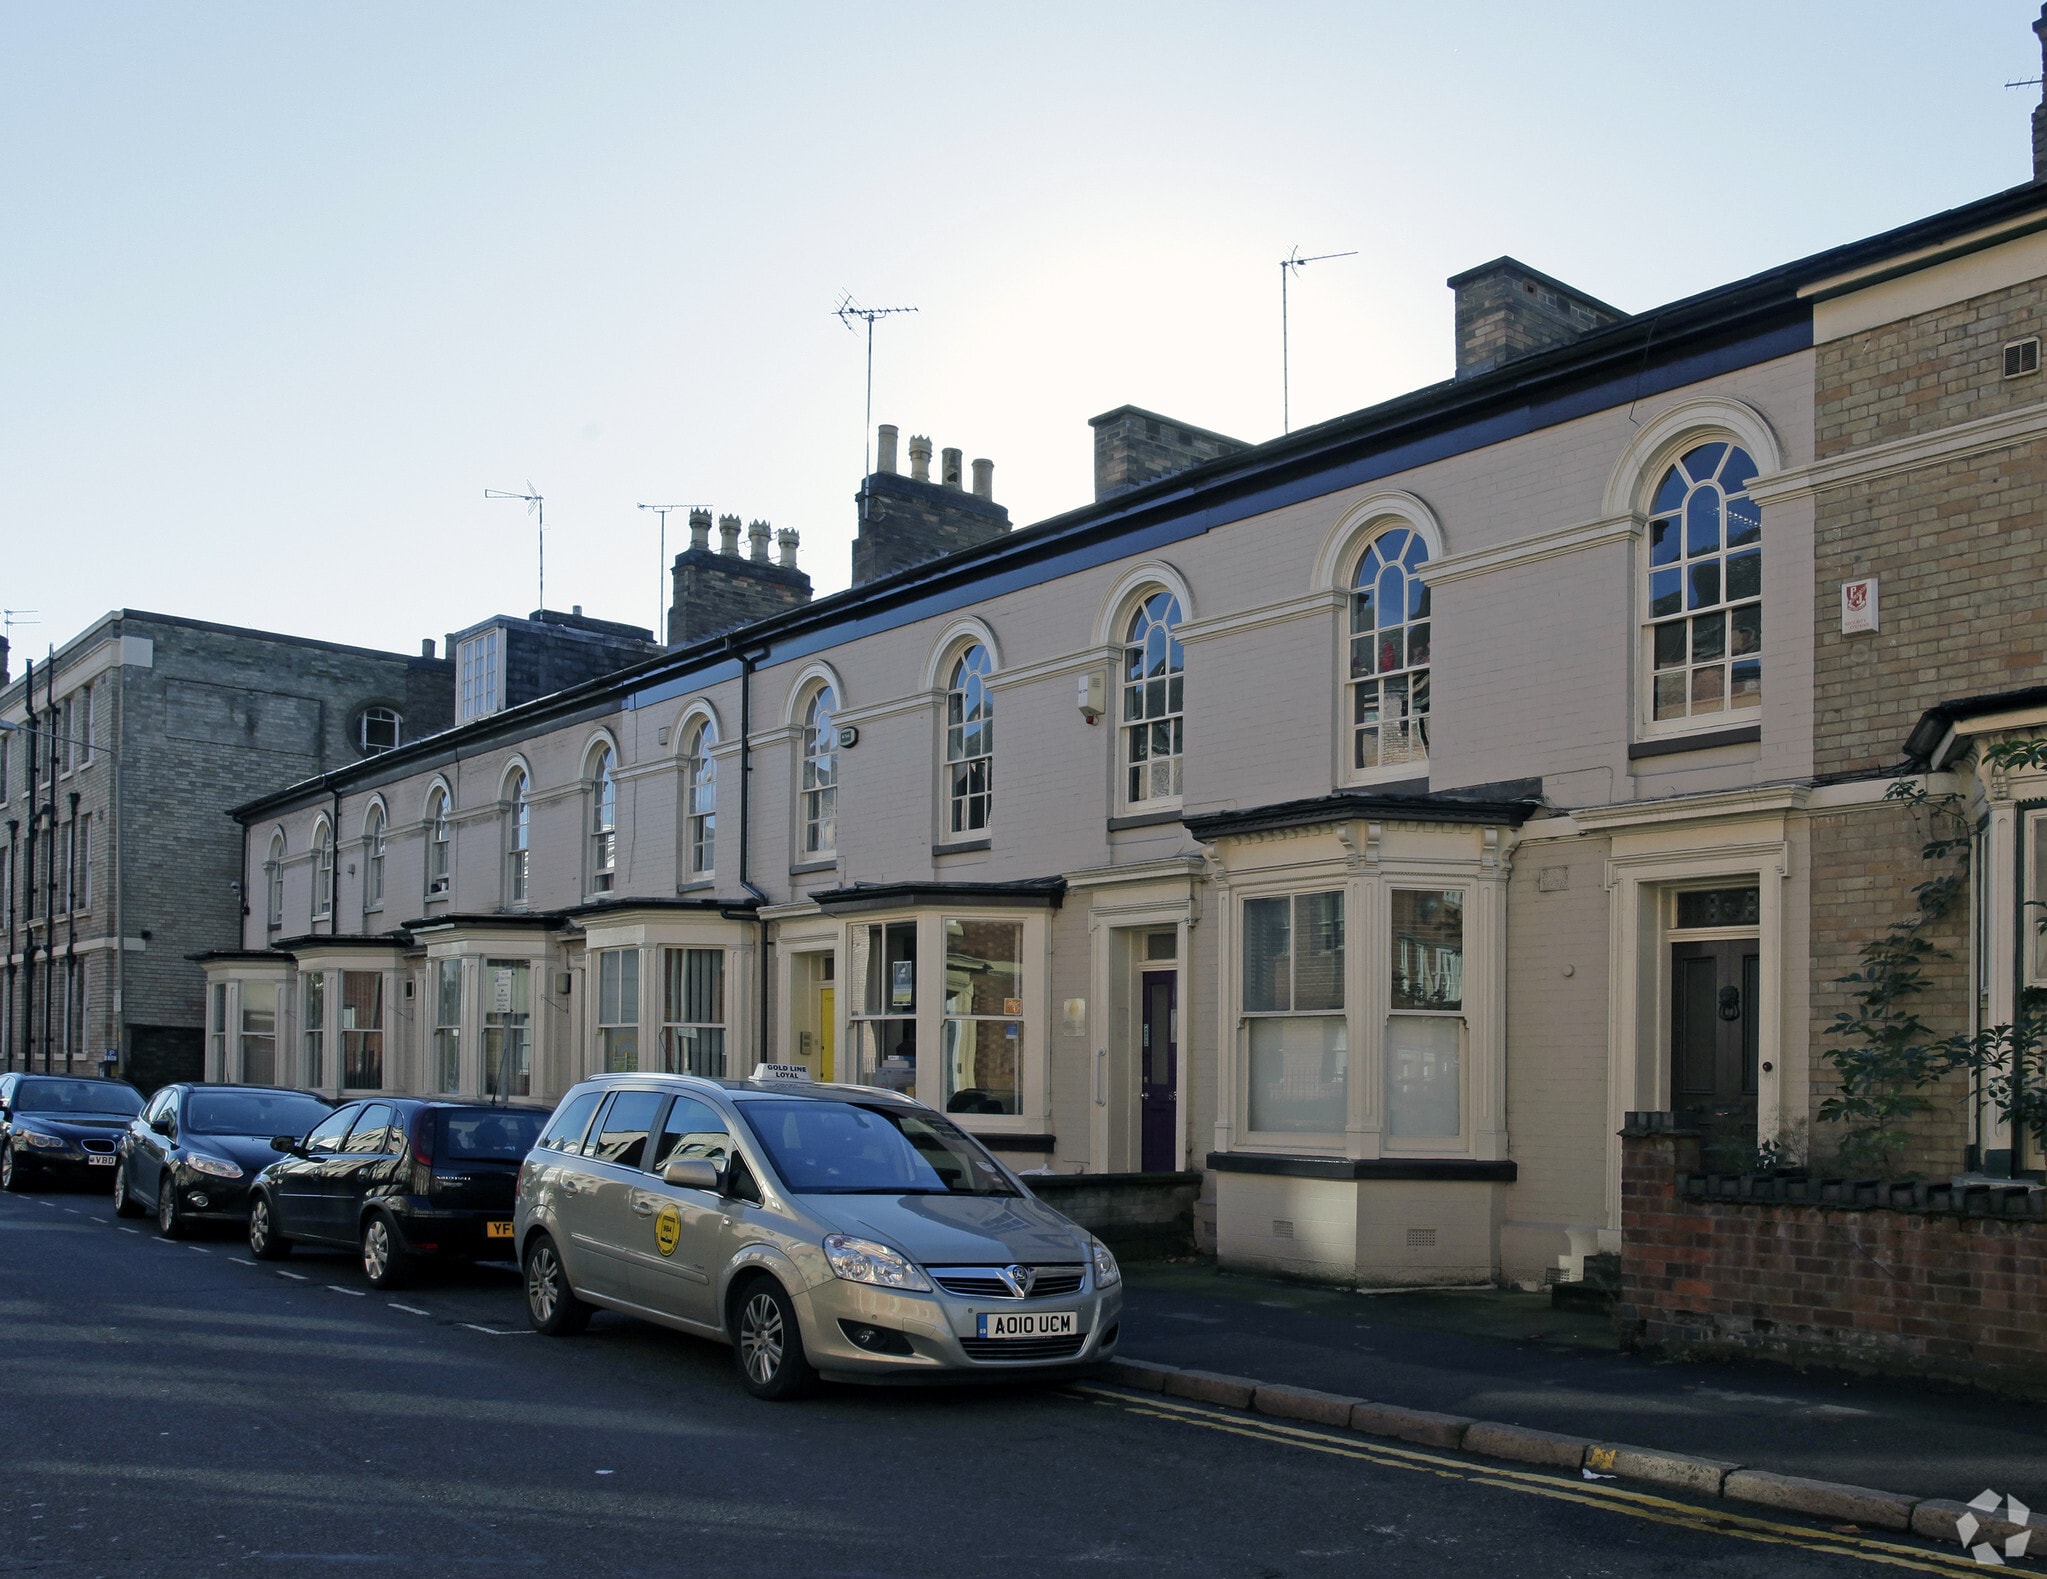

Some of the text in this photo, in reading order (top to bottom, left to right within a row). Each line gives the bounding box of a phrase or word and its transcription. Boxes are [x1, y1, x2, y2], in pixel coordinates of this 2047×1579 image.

[775, 1071, 799, 1079] LOYAL
[995, 1315, 1071, 1334] AO10 UCM
